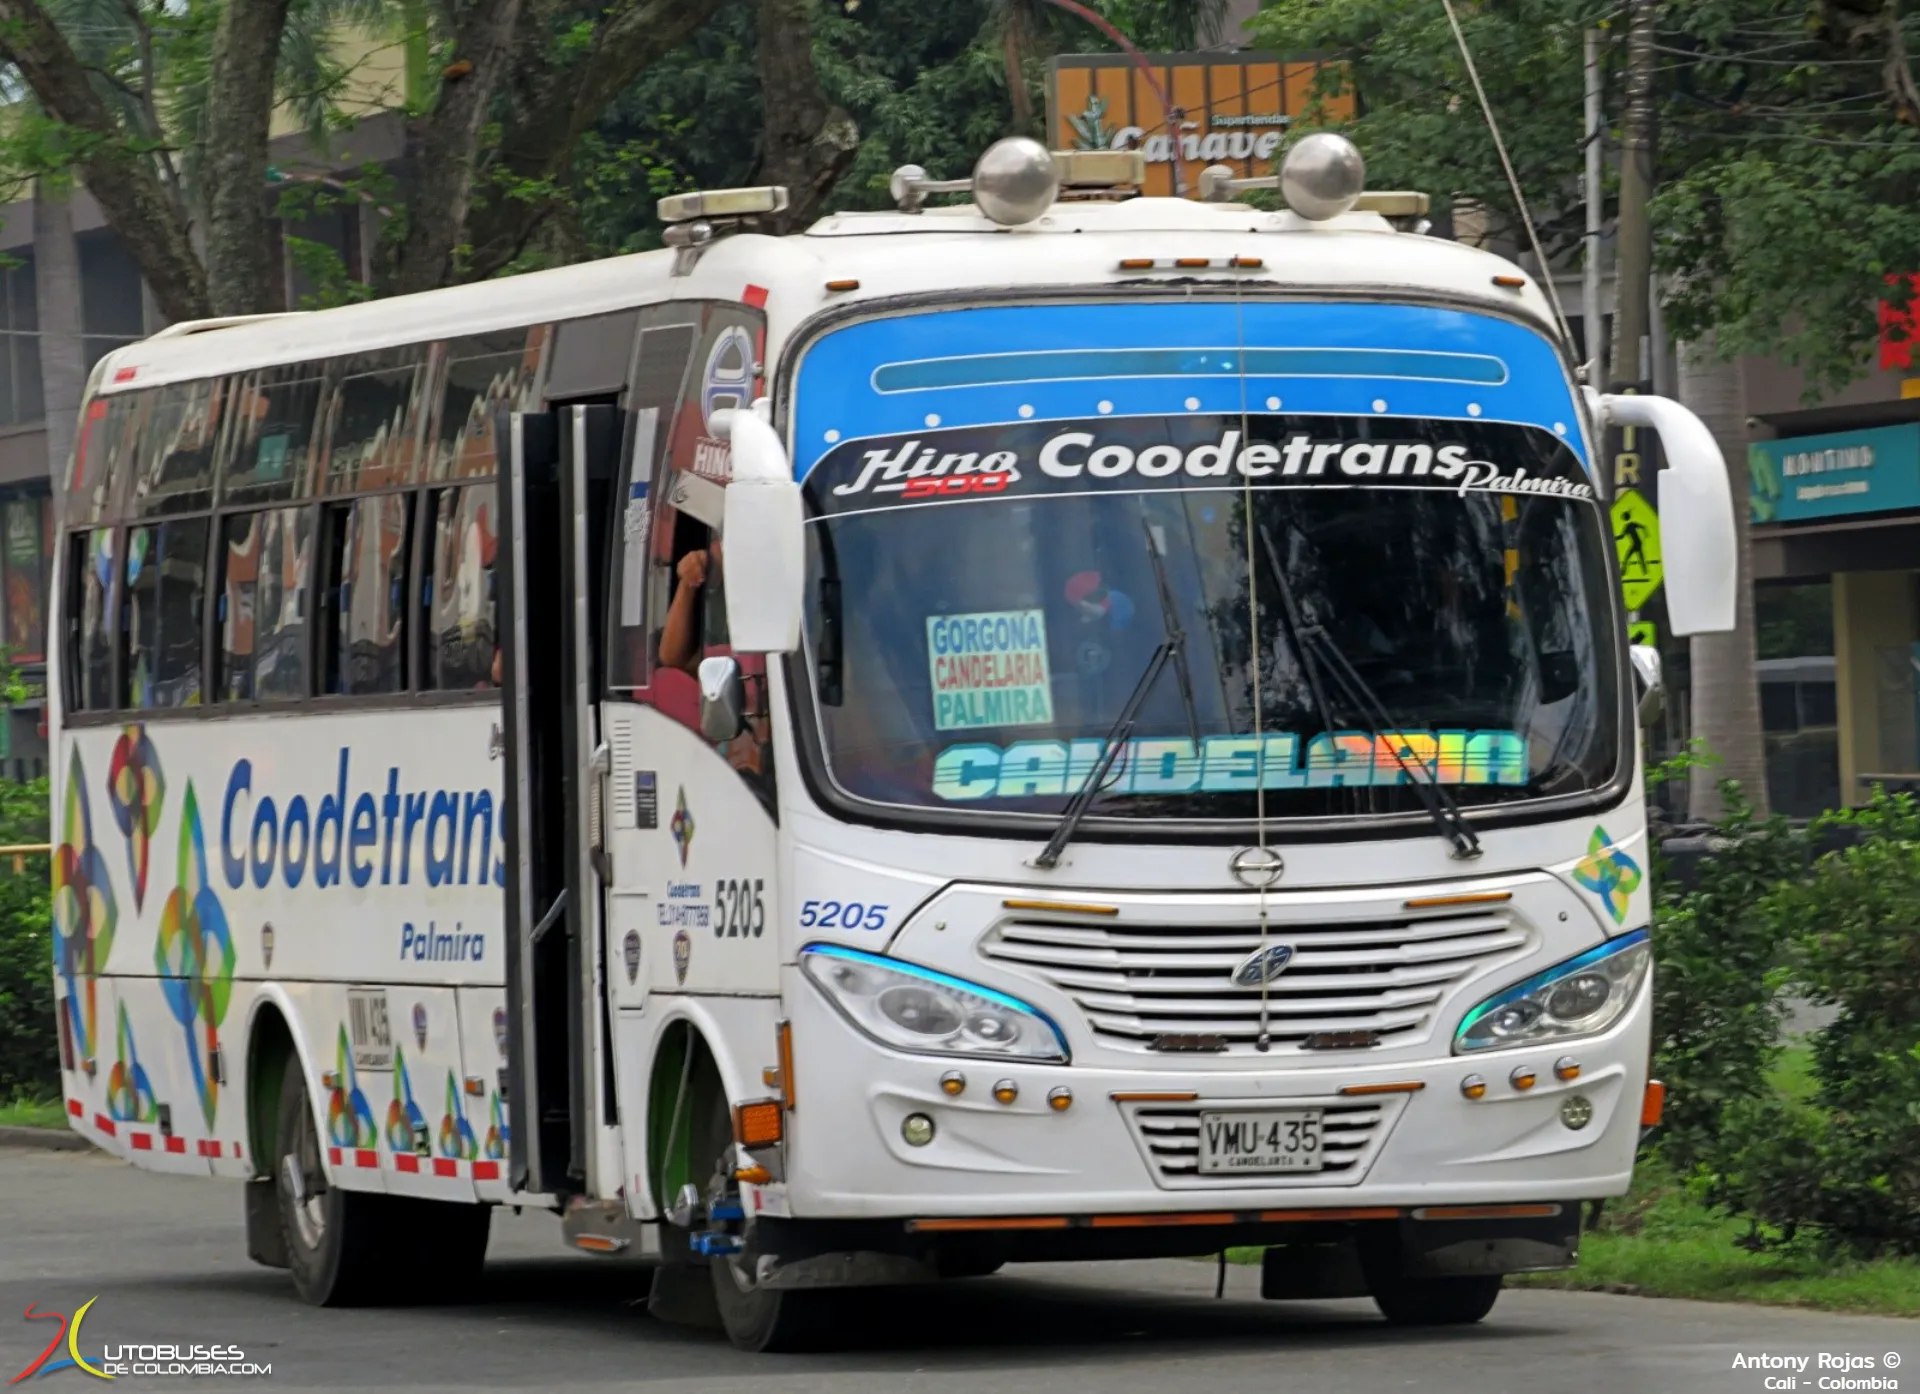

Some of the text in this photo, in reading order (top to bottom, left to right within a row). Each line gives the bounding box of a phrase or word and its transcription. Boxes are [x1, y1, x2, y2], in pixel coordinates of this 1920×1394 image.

[833, 440, 1021, 495] Hino
[1038, 431, 1467, 478] Coodetrans
[1458, 460, 1593, 498] Palmira
[933, 617, 1041, 655] GORGONA
[935, 653, 1044, 690] CANDELARIA
[937, 688, 1049, 727] PALMIRA
[932, 729, 1528, 800] CANDELARIA
[714, 879, 764, 939] 5205
[800, 901, 888, 931] 5205
[399, 920, 485, 961] Palmira
